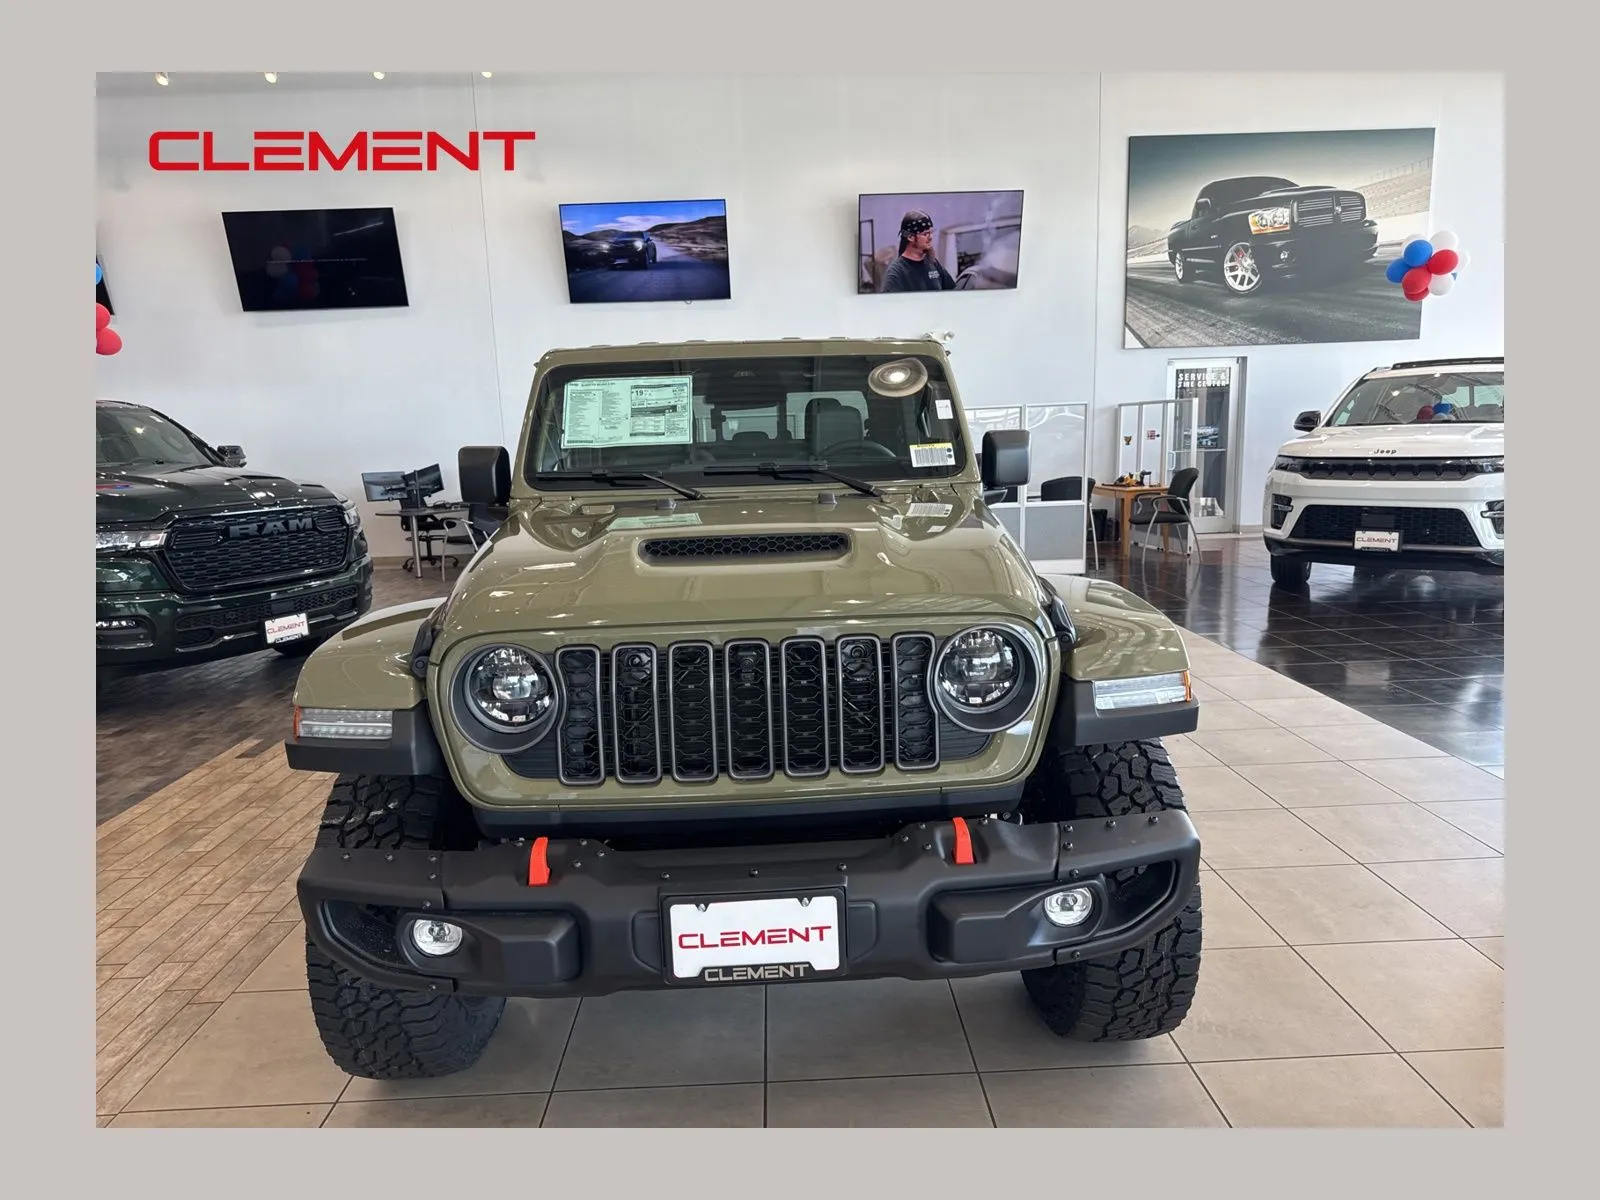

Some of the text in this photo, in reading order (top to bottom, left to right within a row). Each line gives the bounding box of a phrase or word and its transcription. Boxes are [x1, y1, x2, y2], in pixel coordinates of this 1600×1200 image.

[1177, 380, 1227, 388] TIRE CETER
[229, 517, 313, 539] RAM
[267, 621, 305, 634] CLEMENT
[678, 926, 832, 950] CLEMENT
[704, 964, 810, 982] CLEMENT
